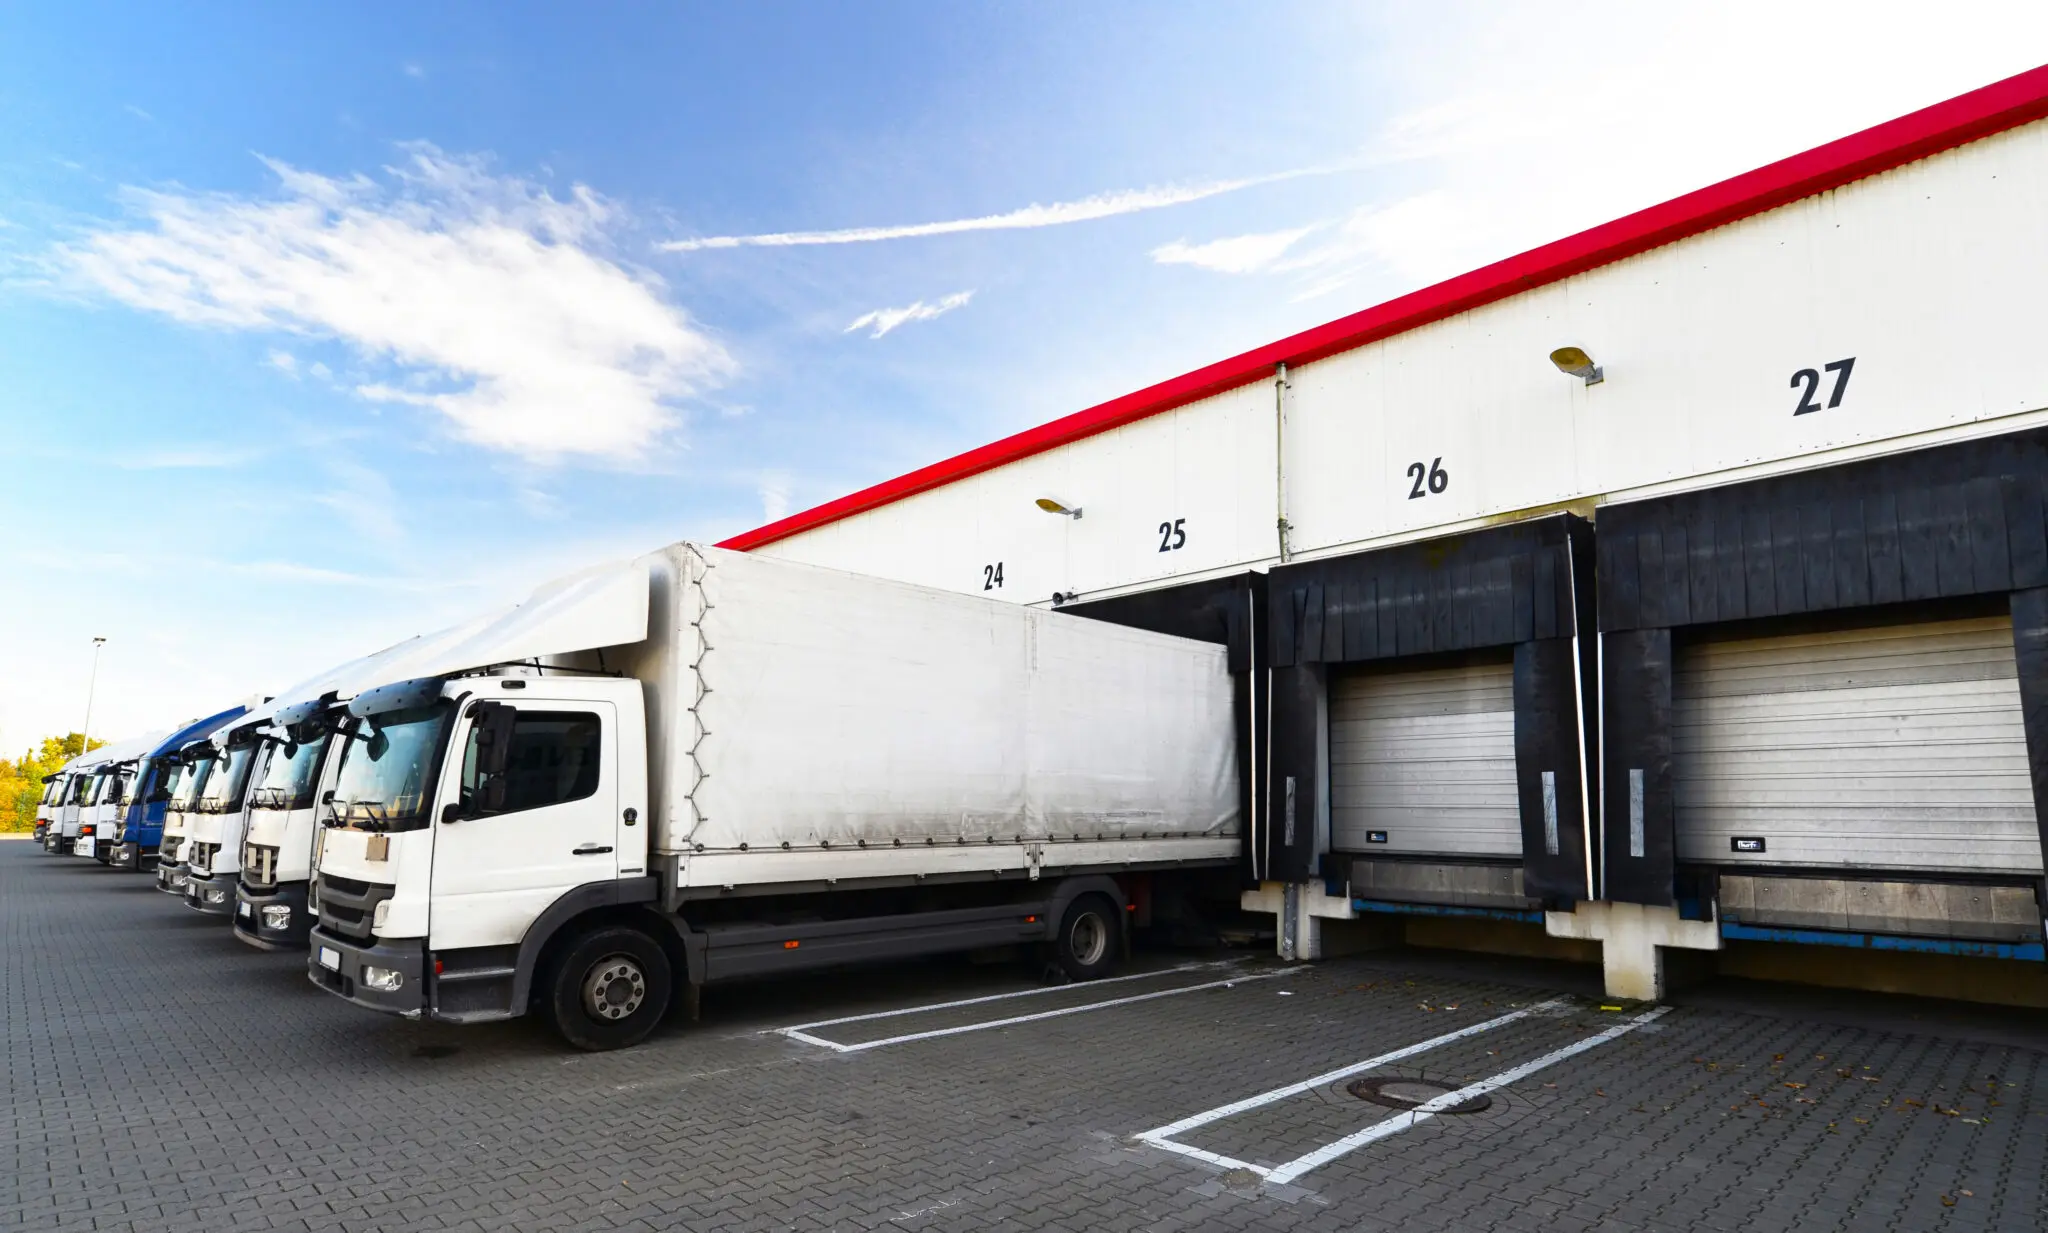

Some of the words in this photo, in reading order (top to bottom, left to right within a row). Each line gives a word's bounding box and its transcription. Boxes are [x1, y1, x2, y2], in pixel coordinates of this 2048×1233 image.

[1790, 357, 1857, 417] 27
[1407, 457, 1449, 500] 26
[1158, 519, 1186, 553] 25
[983, 562, 1004, 591] 24
